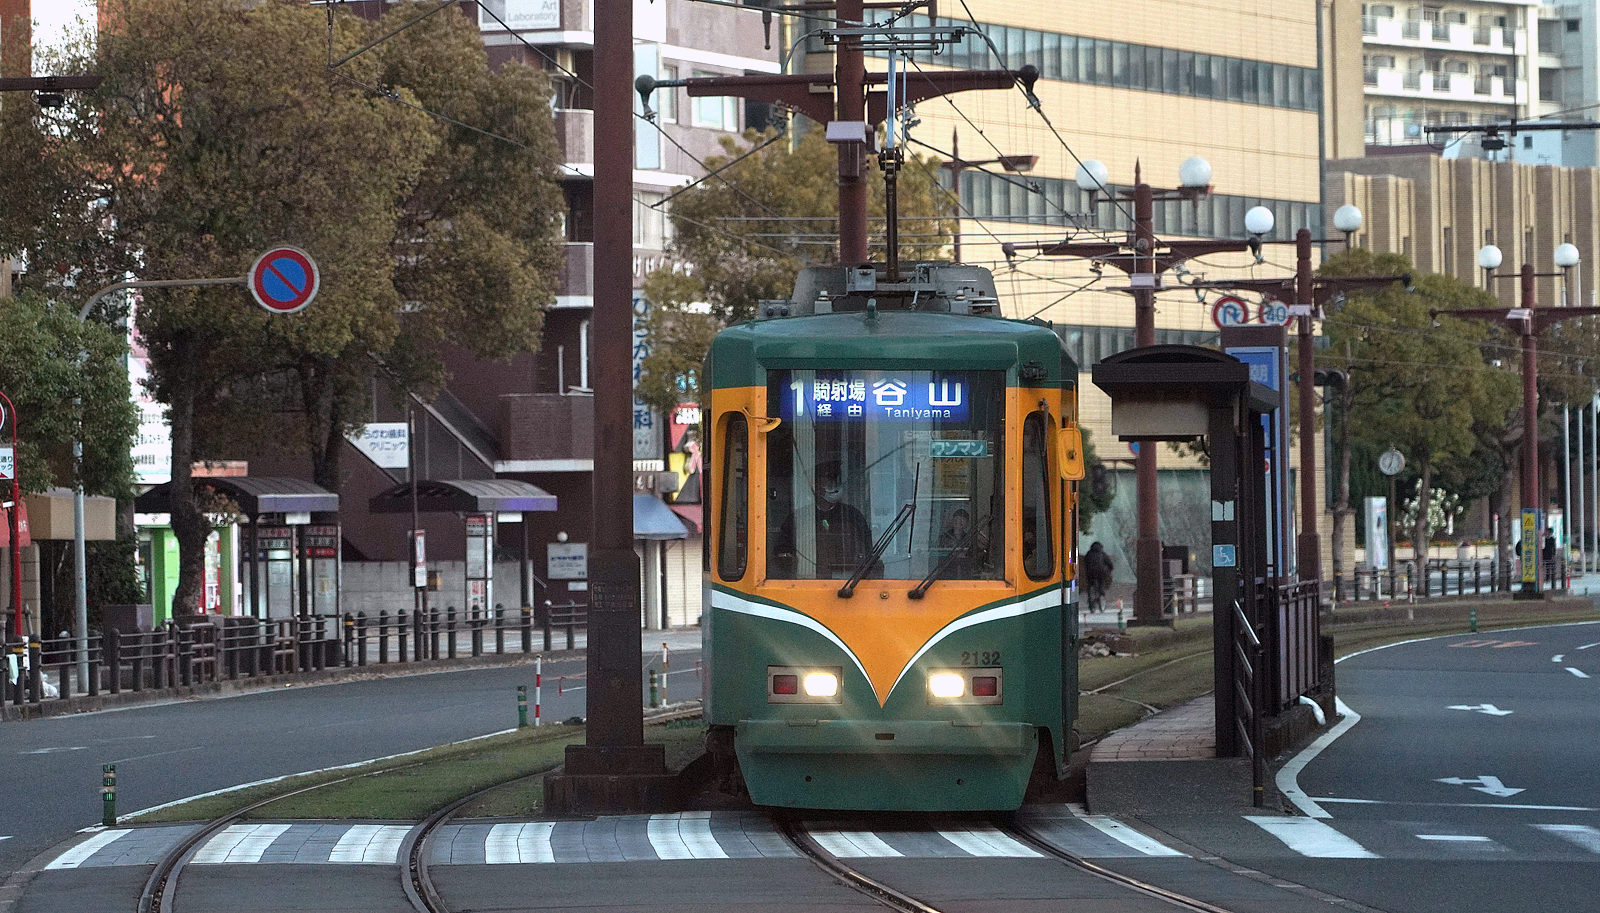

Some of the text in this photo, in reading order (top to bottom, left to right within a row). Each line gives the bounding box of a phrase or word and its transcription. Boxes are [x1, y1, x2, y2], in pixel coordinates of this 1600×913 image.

[541, 1, 557, 10] Art
[507, 12, 557, 22] Laboratory
[1266, 305, 1287, 322] 40
[633, 298, 653, 429] ひらか科
[813, 378, 866, 402] 騎射場
[872, 378, 962, 406] 谷山
[790, 379, 804, 417] 1
[817, 403, 862, 417] 経由
[884, 407, 951, 419] Taniyama
[362, 428, 406, 439] らかわ歯科
[369, 441, 406, 451] クリニック
[932, 441, 985, 456] ワンマン
[961, 651, 1001, 666] 2132
